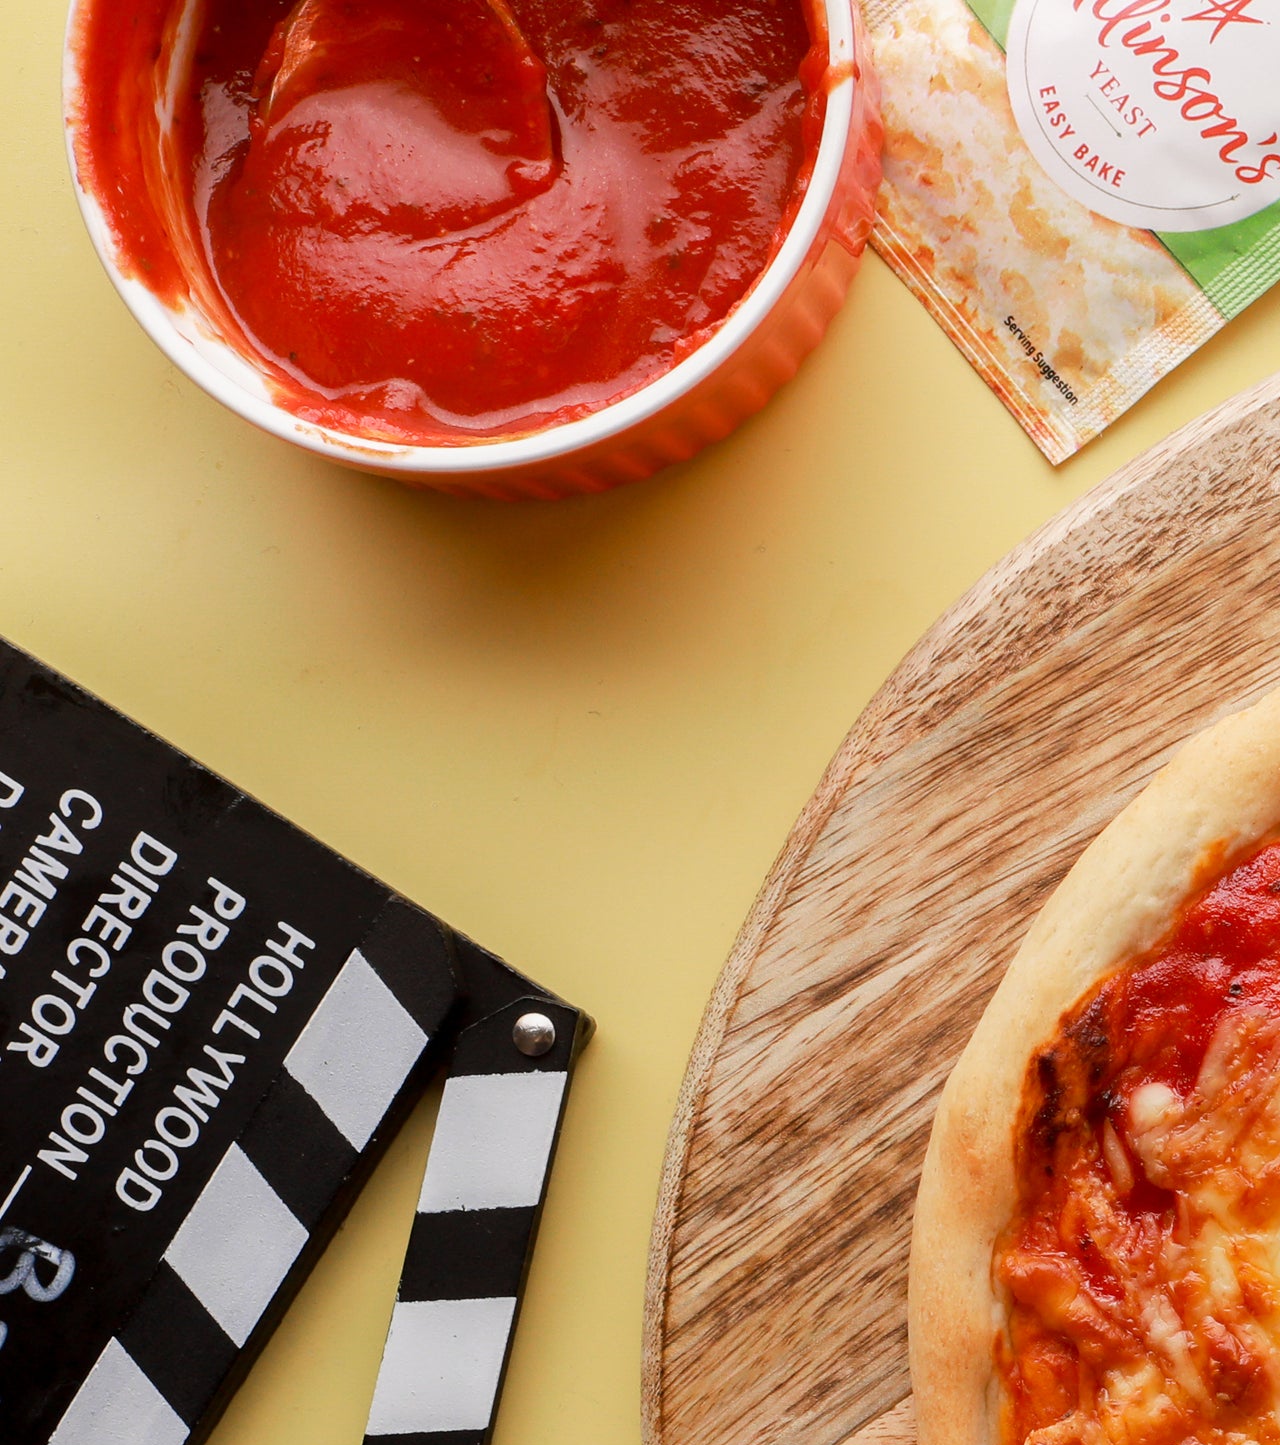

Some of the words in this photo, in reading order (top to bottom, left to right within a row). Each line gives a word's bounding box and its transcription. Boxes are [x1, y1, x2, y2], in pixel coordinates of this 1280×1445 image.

[1039, 85, 1075, 139] EASY
[1073, 143, 1126, 187] BAKE
[1090, 60, 1156, 137] YEAST
[1004, 315, 1036, 356] Serving
[1033, 352, 1078, 405] Suggestion
[0, 788, 103, 980] CAMER
[7, 830, 178, 1068] DIRECTOR
[36, 876, 246, 1181] PRODUCTION
[115, 921, 316, 1212] HOLLYWOOD
